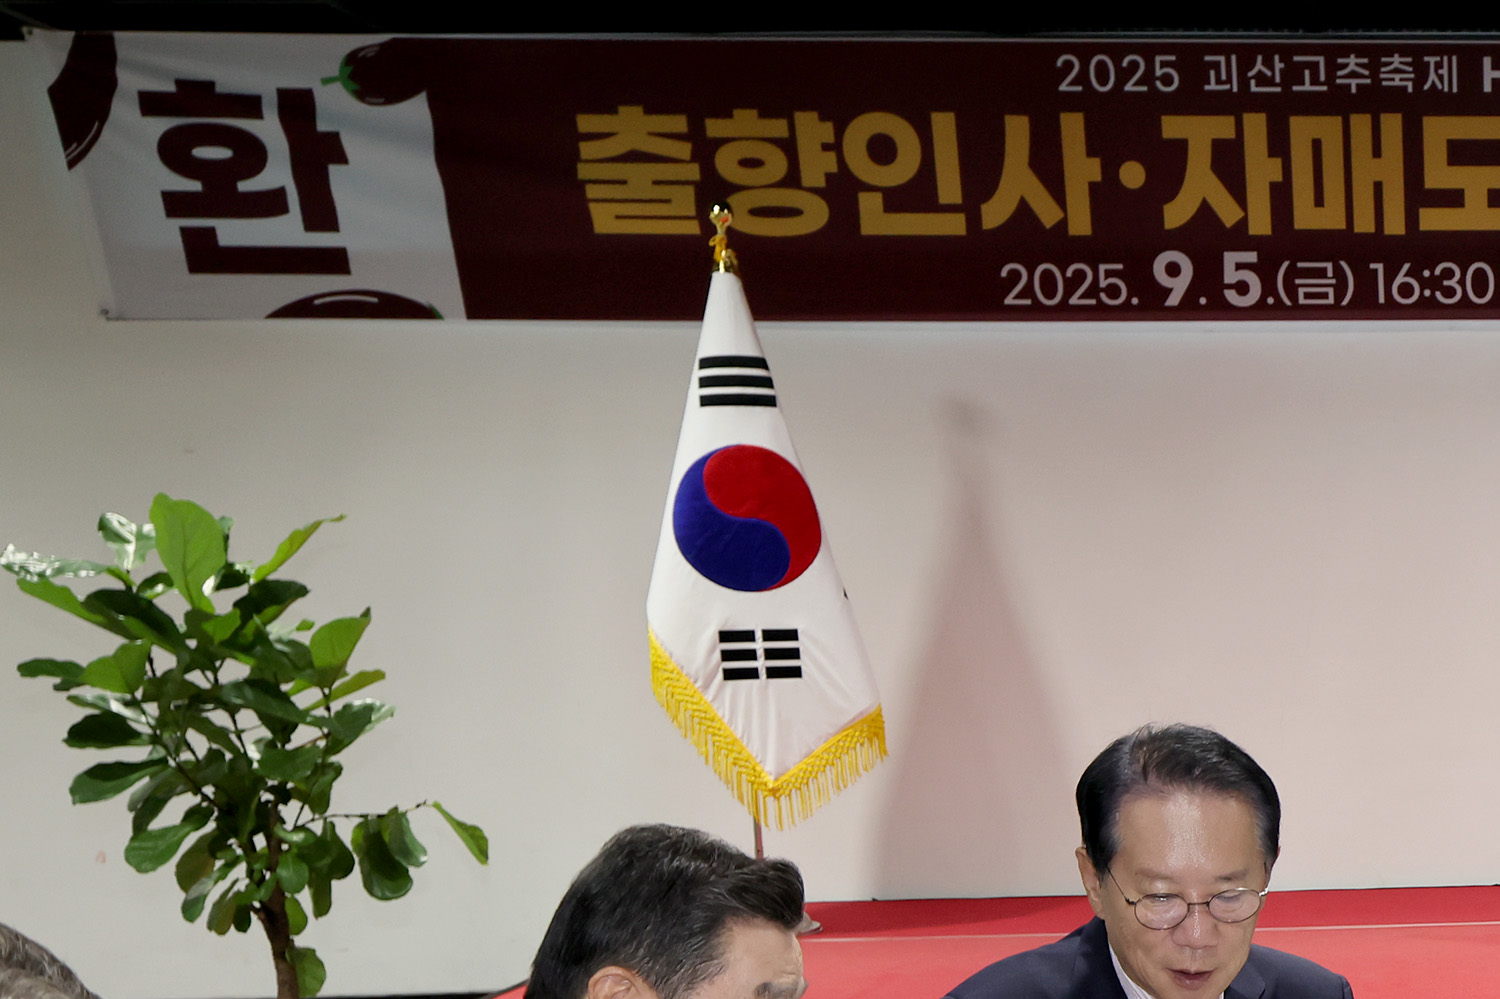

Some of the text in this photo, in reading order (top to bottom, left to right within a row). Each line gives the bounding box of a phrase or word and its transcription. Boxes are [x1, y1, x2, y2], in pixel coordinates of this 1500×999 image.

[1056, 54, 1180, 93] 2025
[1203, 54, 1458, 94] 괴산고추축제
[137, 79, 350, 275] 환
[1000, 262, 1139, 305] 2025.
[1370, 262, 1494, 305] 16:30
